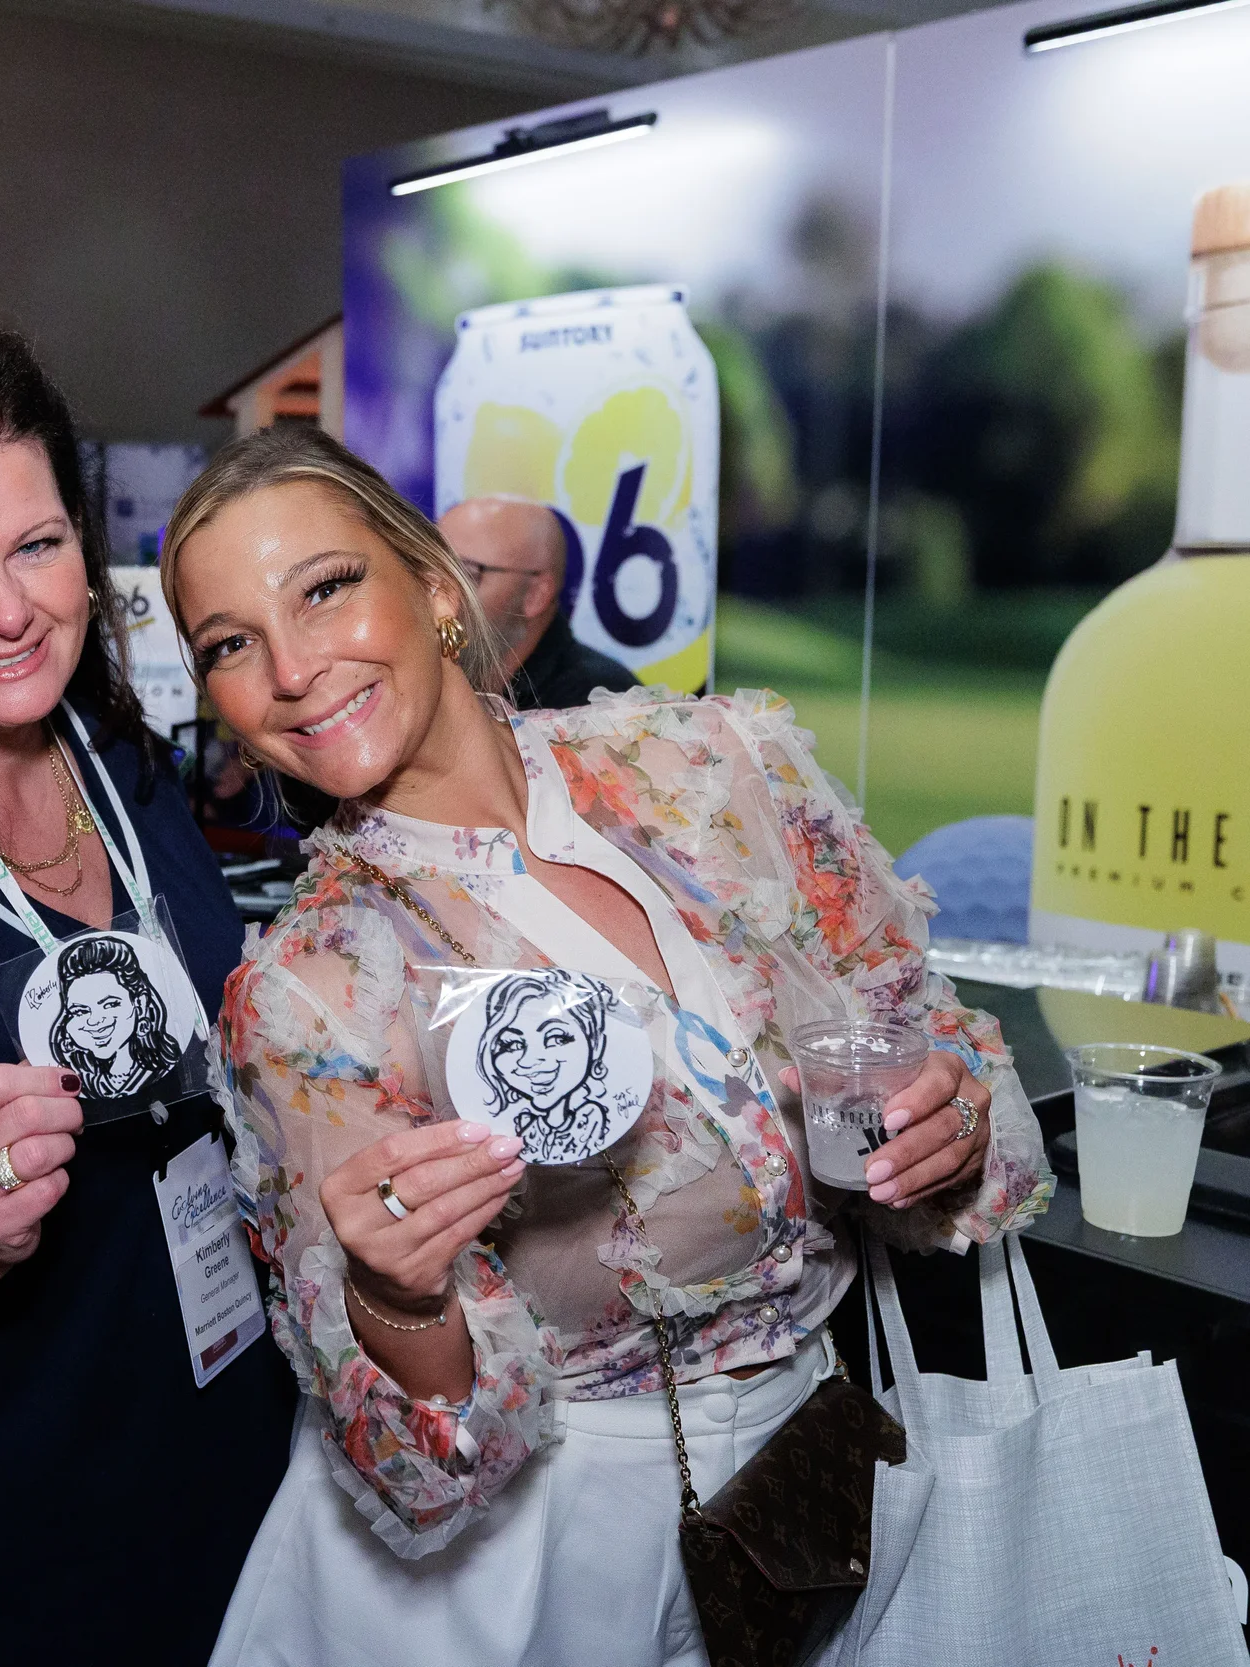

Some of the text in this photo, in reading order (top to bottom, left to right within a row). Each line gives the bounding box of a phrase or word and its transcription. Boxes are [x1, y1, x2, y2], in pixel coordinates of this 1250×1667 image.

[1058, 795, 1230, 869] ON THE
[839, 1110, 883, 1125] ROCKS
[195, 1231, 230, 1263] Kimberly
[204, 1256, 229, 1279] Greene
[200, 1271, 240, 1304] General Manager
[195, 1291, 252, 1337] Marriott Boston Quincy
